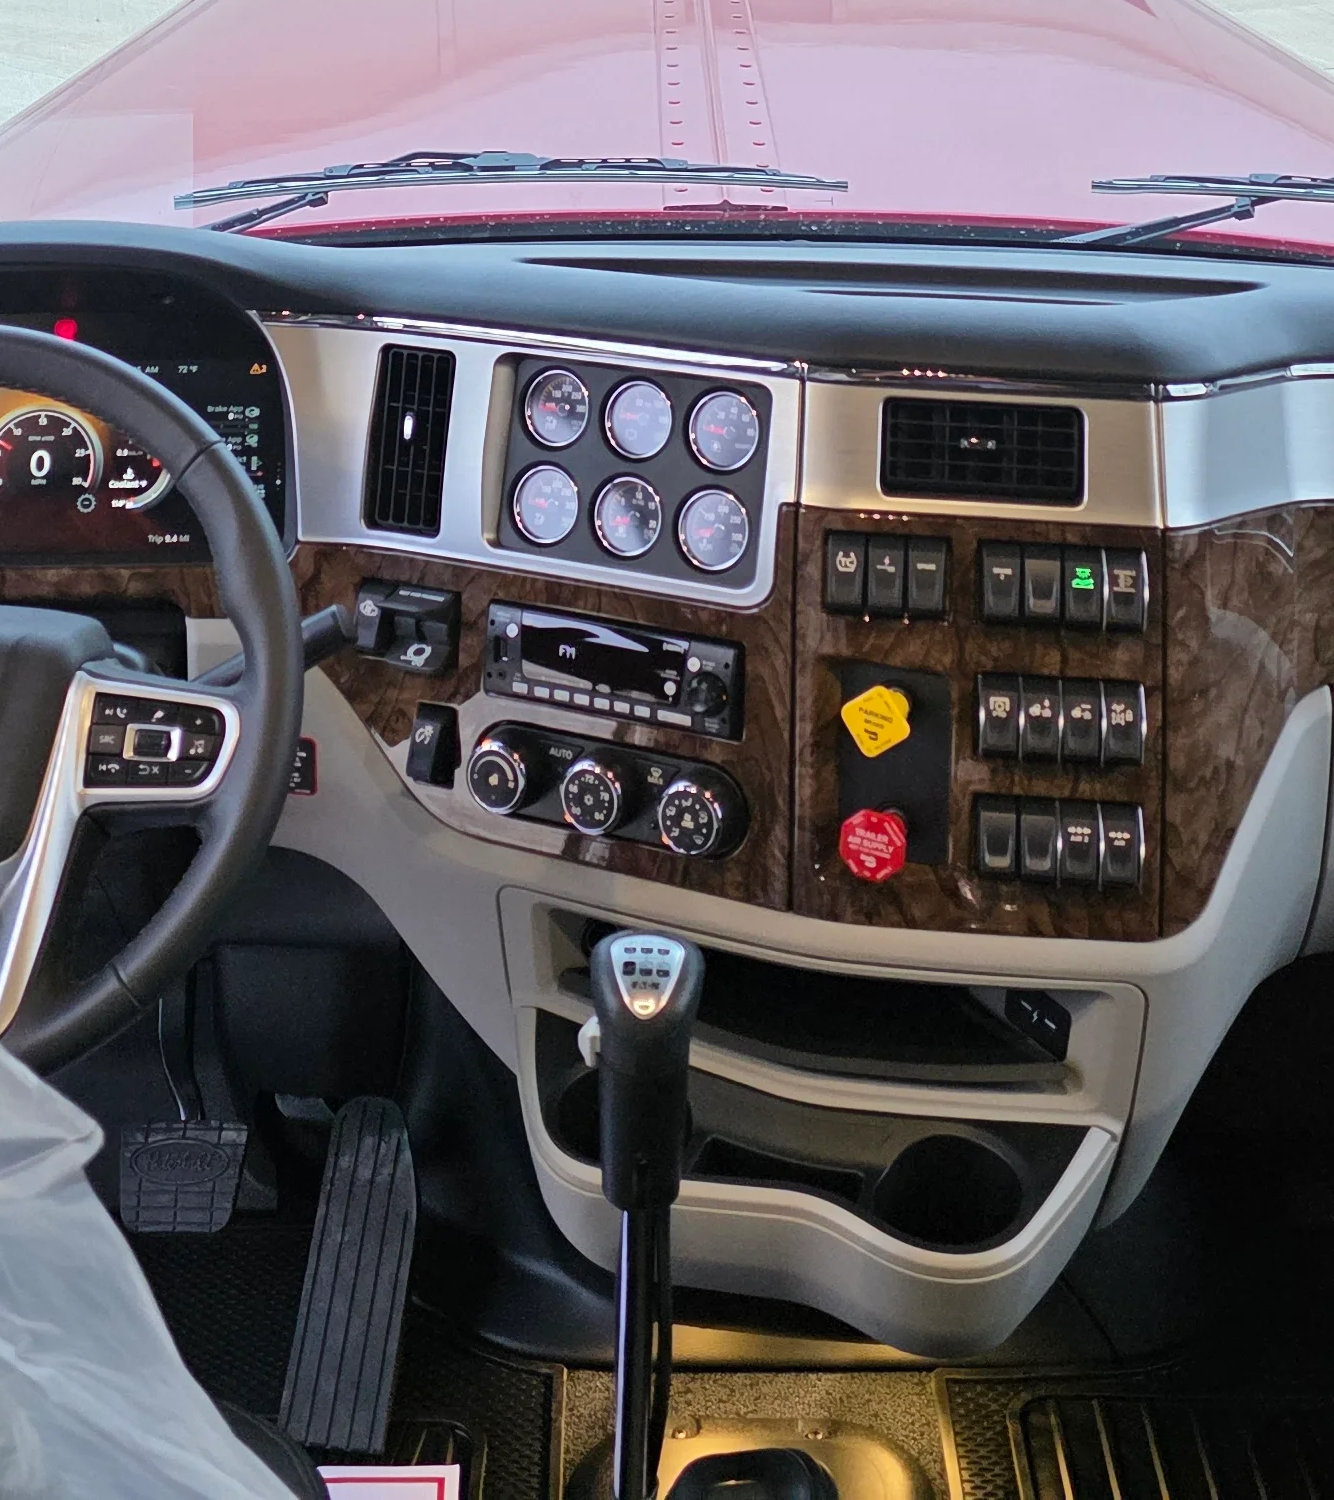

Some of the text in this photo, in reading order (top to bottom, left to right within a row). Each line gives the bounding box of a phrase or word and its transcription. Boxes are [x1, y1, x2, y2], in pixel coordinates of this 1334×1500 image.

[30, 449, 51, 478] 0
[558, 643, 576, 660] FM
[98, 734, 115, 745] SRC
[549, 746, 574, 760] AUTO
[583, 773, 595, 785] 72
